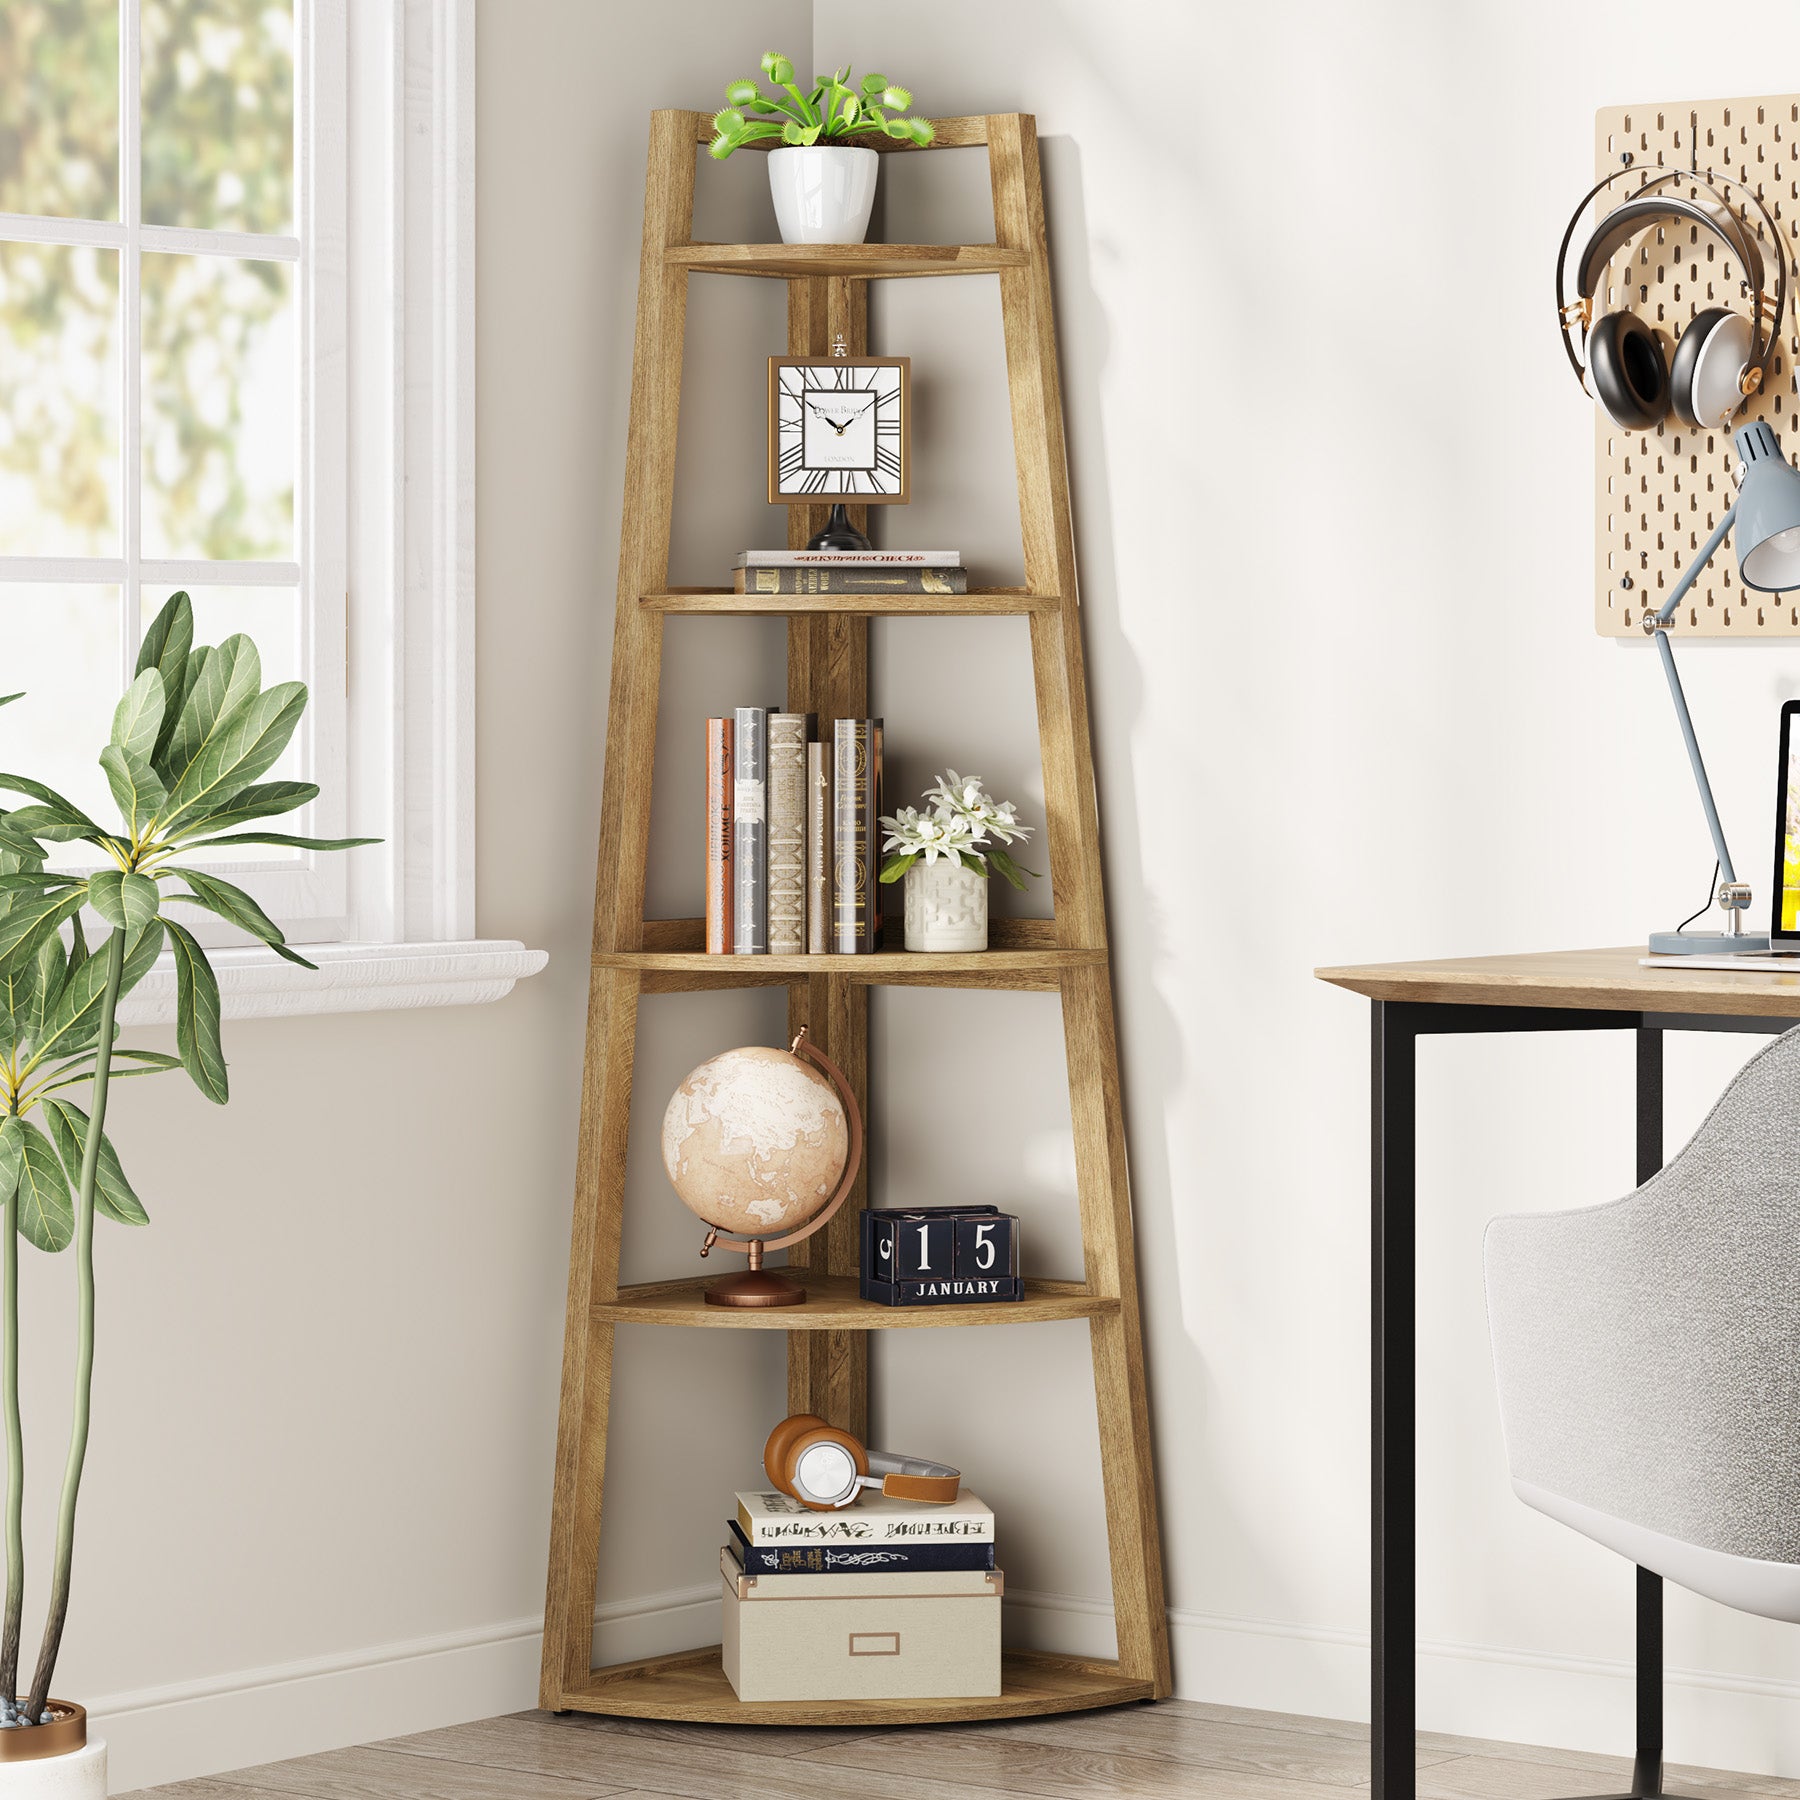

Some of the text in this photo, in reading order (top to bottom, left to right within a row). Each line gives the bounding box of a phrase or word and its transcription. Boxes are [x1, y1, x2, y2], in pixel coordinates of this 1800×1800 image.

[721, 804, 731, 862] ХОЛМСЕ
[916, 1224, 932, 1270] 1
[975, 1223, 996, 1270] 5
[916, 1280, 1000, 1296] JANUARY
